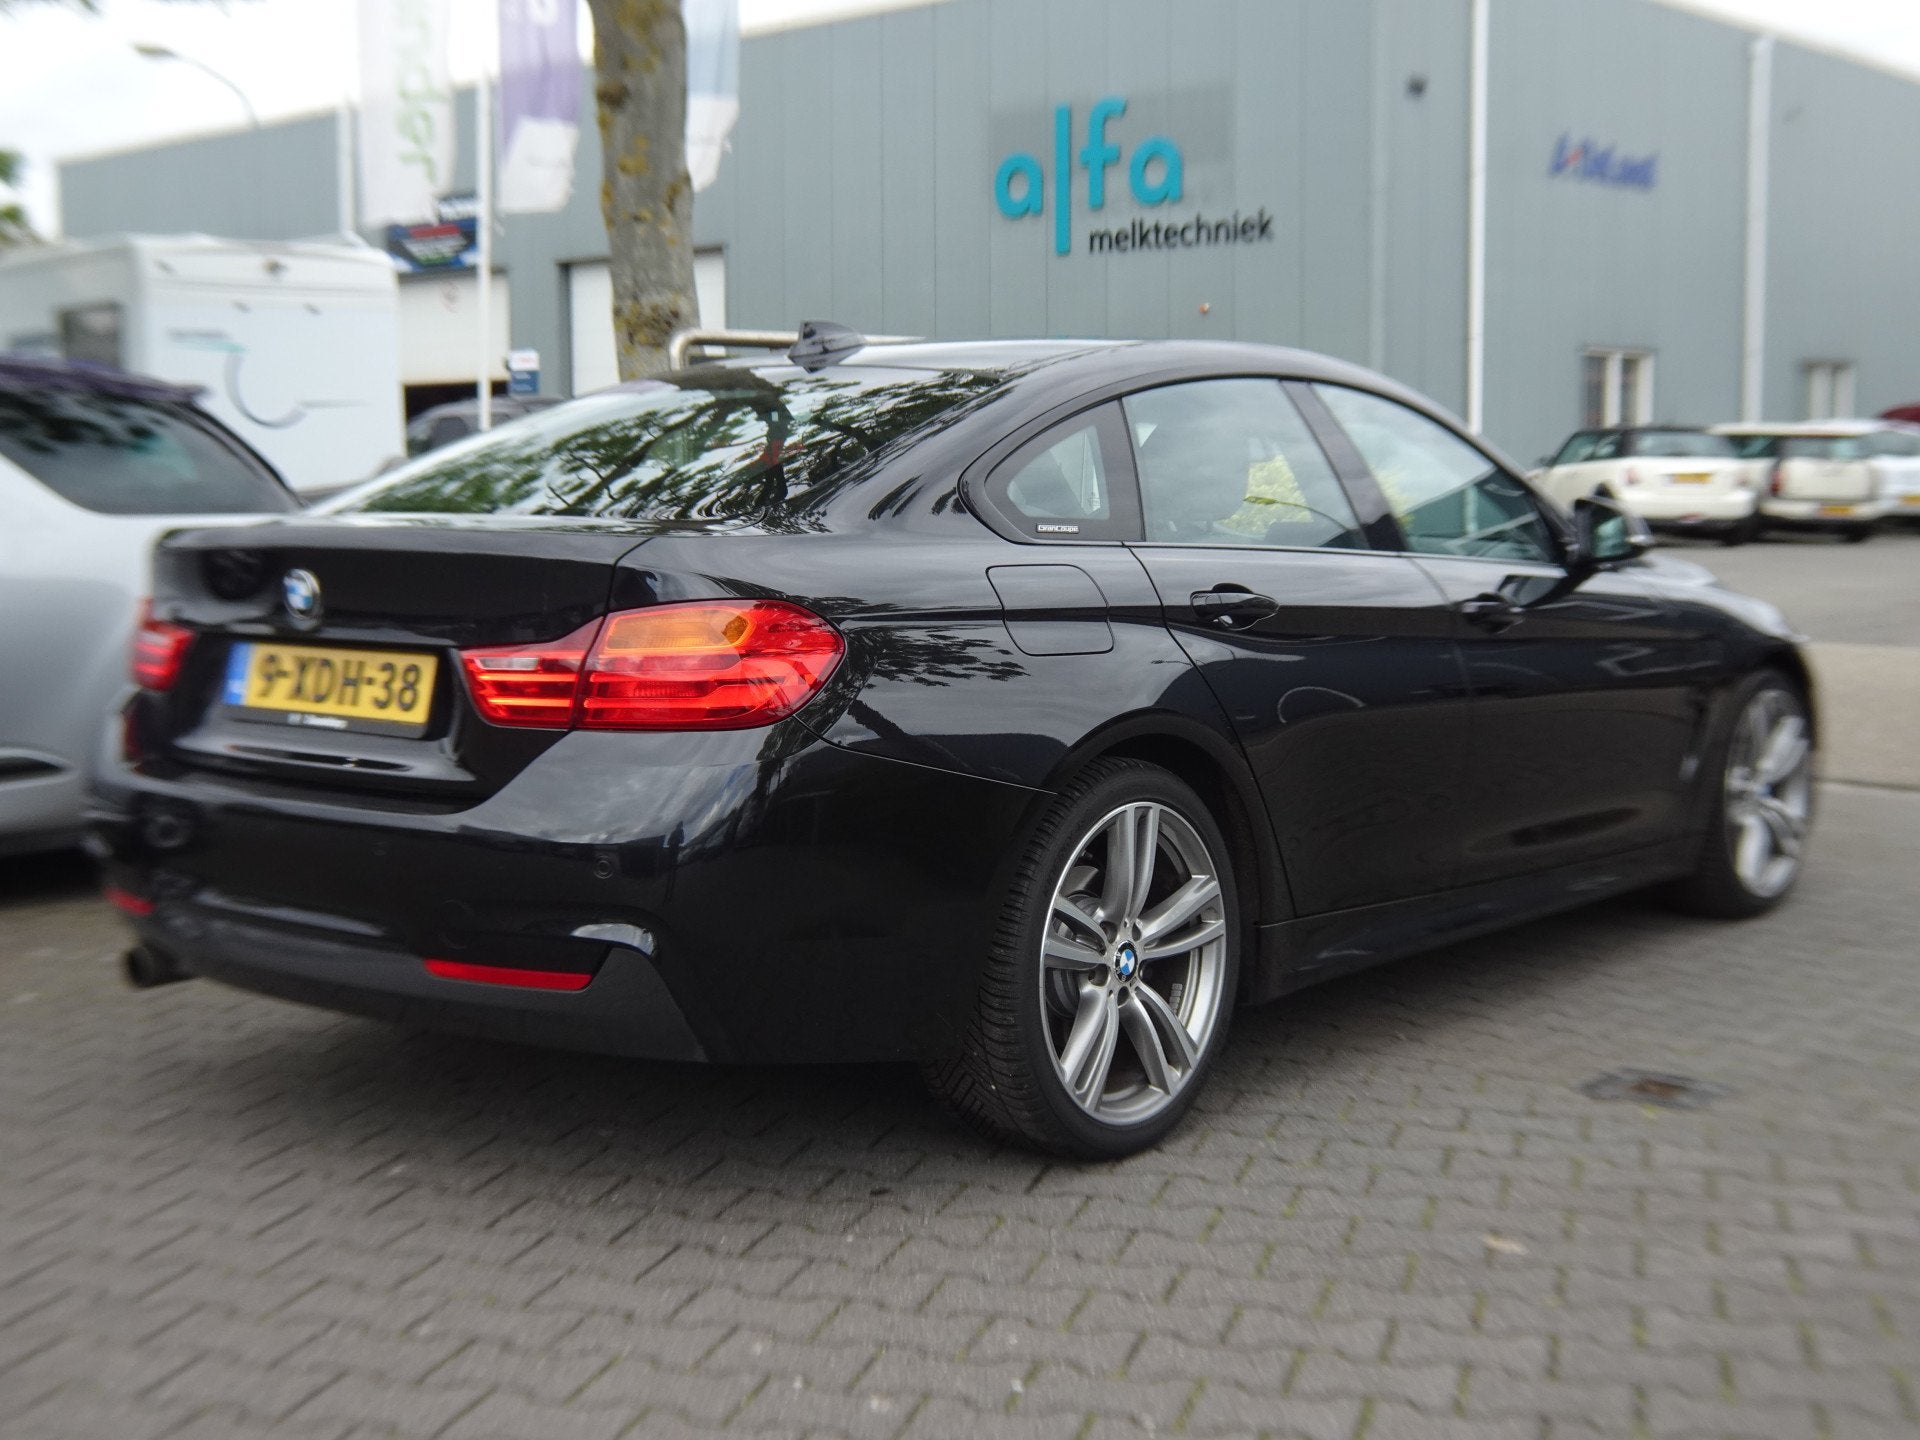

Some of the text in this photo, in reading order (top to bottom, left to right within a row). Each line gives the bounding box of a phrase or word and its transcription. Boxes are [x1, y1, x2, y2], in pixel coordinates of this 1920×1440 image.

[995, 96, 1184, 256] alfa
[1089, 207, 1274, 254] melktechniek
[258, 654, 422, 711] 9-XDH-38
